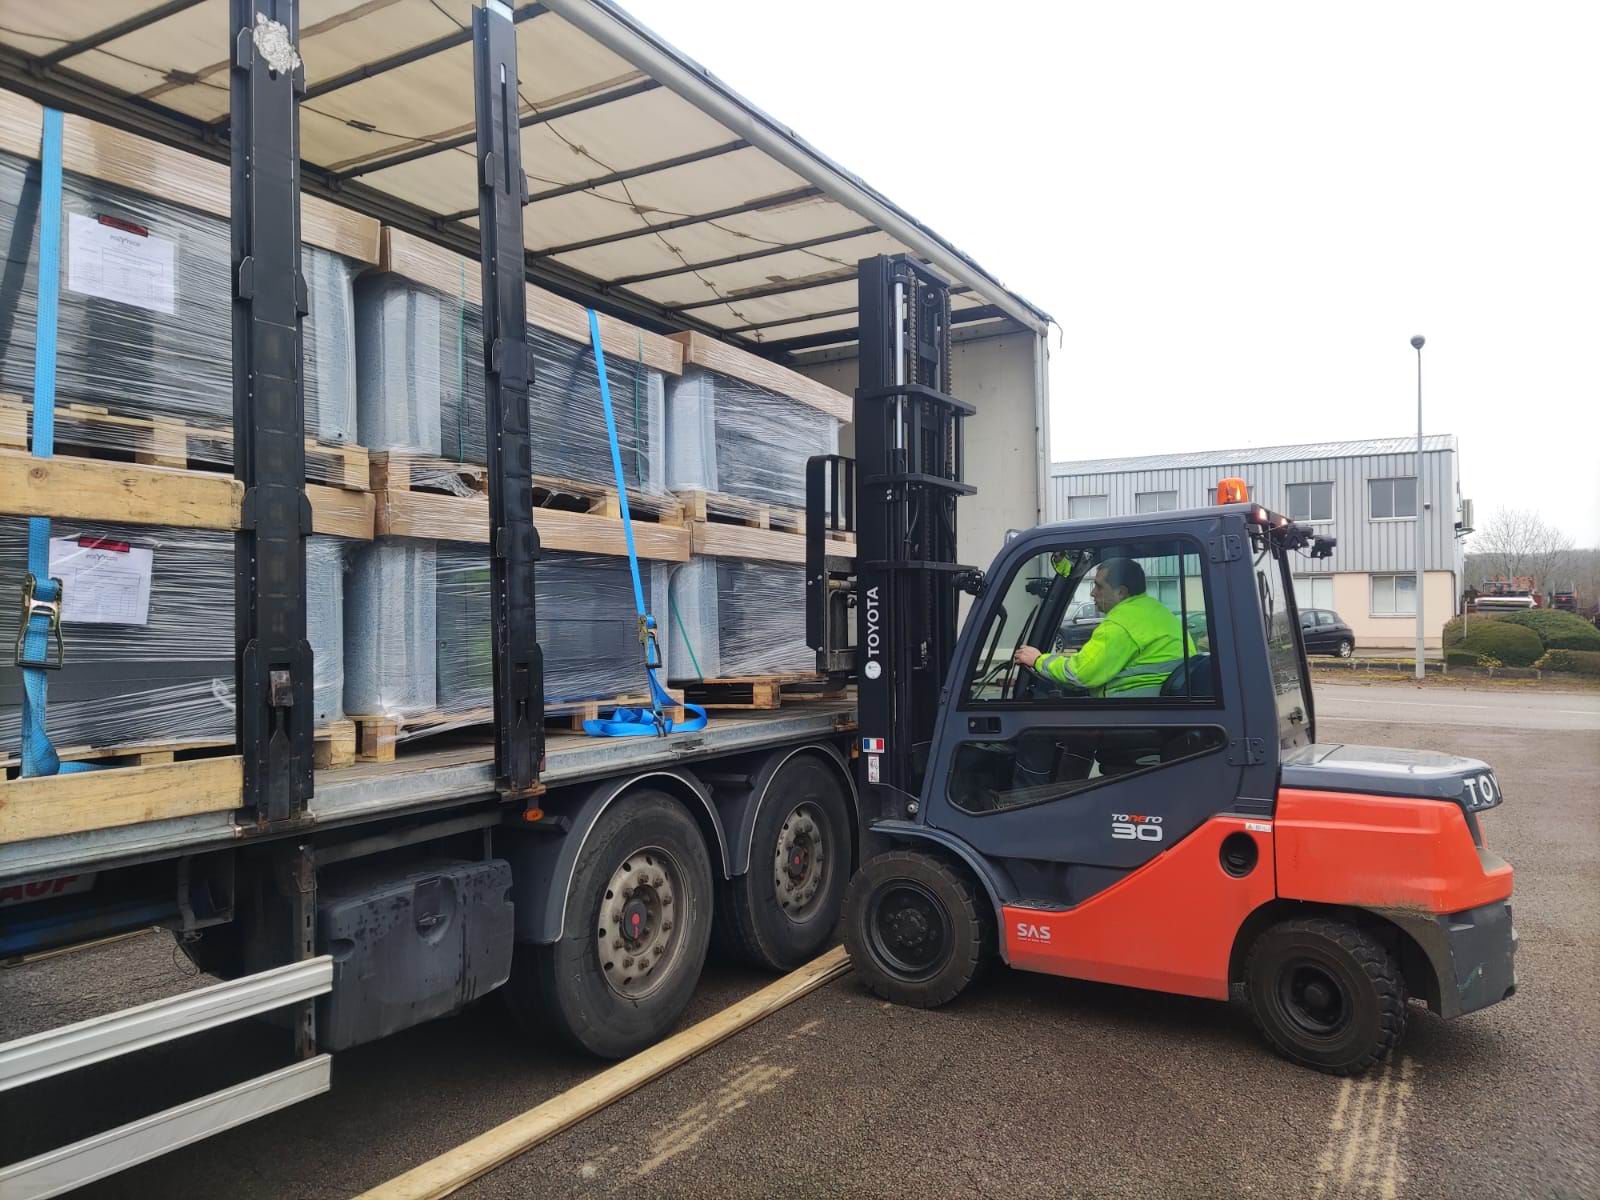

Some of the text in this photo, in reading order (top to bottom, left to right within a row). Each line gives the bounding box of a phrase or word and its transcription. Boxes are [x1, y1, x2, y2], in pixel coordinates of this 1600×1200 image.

[866, 586, 880, 658] TOYOTA
[1111, 822, 1163, 842] 30
[1017, 922, 1051, 940] SAS
